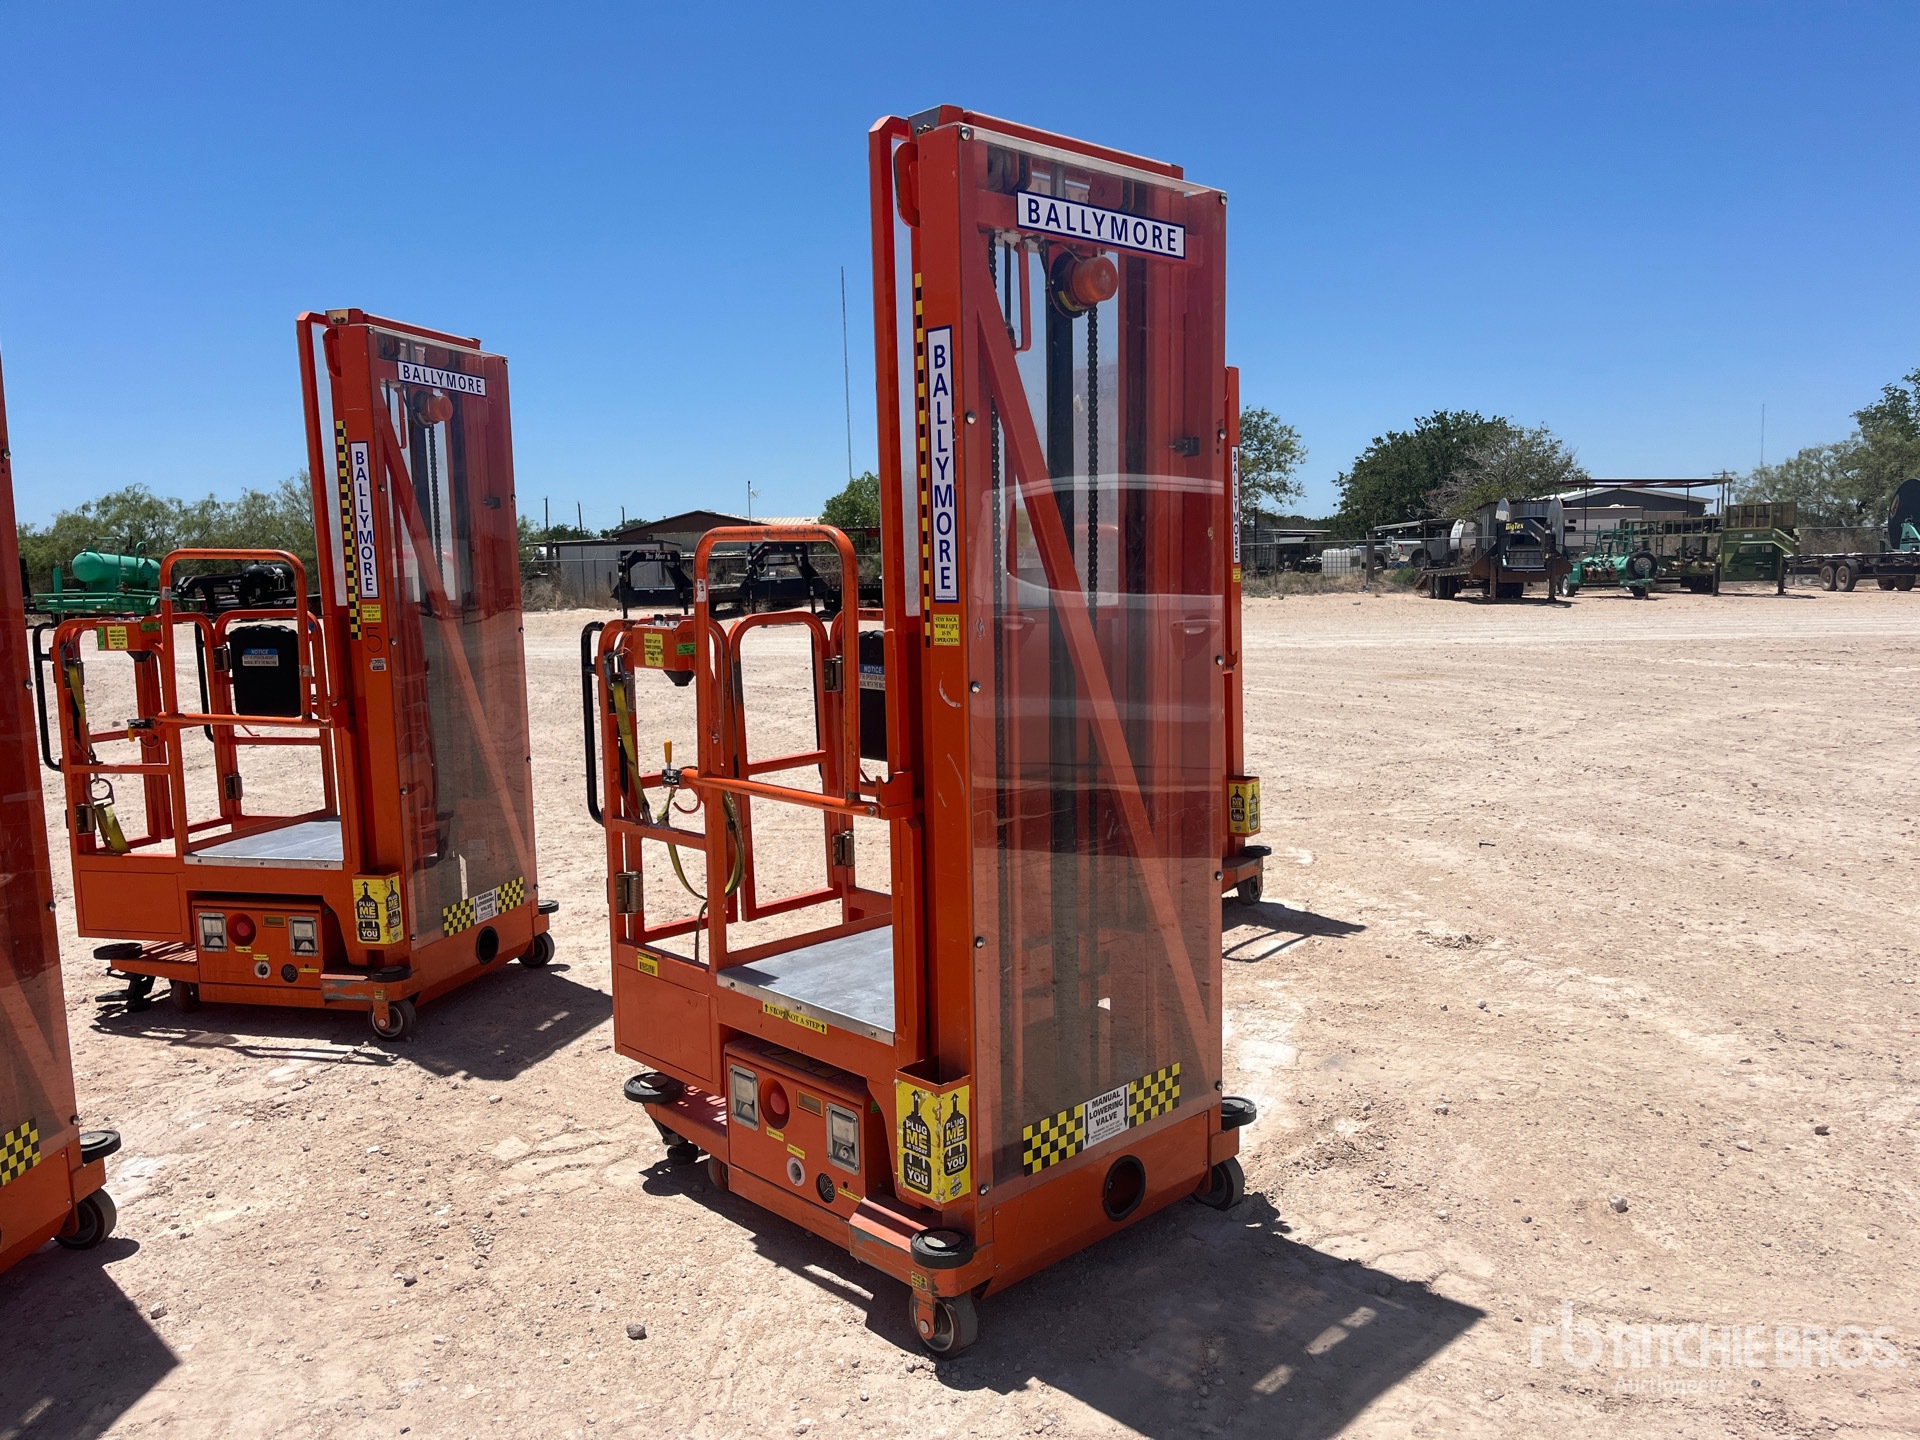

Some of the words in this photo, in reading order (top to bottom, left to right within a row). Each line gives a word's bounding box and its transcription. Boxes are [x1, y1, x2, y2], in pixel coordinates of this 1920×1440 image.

[1027, 198, 1177, 252] BALLYMORE
[402, 364, 482, 393] BALLYMORE
[932, 344, 953, 590] BALLYMORE
[355, 451, 374, 591] BALLYMORE
[366, 627, 382, 653] 5
[864, 666, 882, 674] NOTICE
[360, 907, 376, 915] ME
[806, 1020, 820, 1030] STEP
[1092, 1090, 1120, 1109] MANUAL
[1089, 1098, 1124, 1120] LOWERING
[946, 1117, 964, 1130] PLUG
[1096, 1110, 1118, 1126] VALVE
[906, 1120, 928, 1135] PLUG
[946, 1124, 964, 1141] ME
[906, 1129, 928, 1150] ME
[912, 1145, 928, 1155] TODAY
[947, 1156, 965, 1170] YOU
[907, 1168, 928, 1186] YOU
